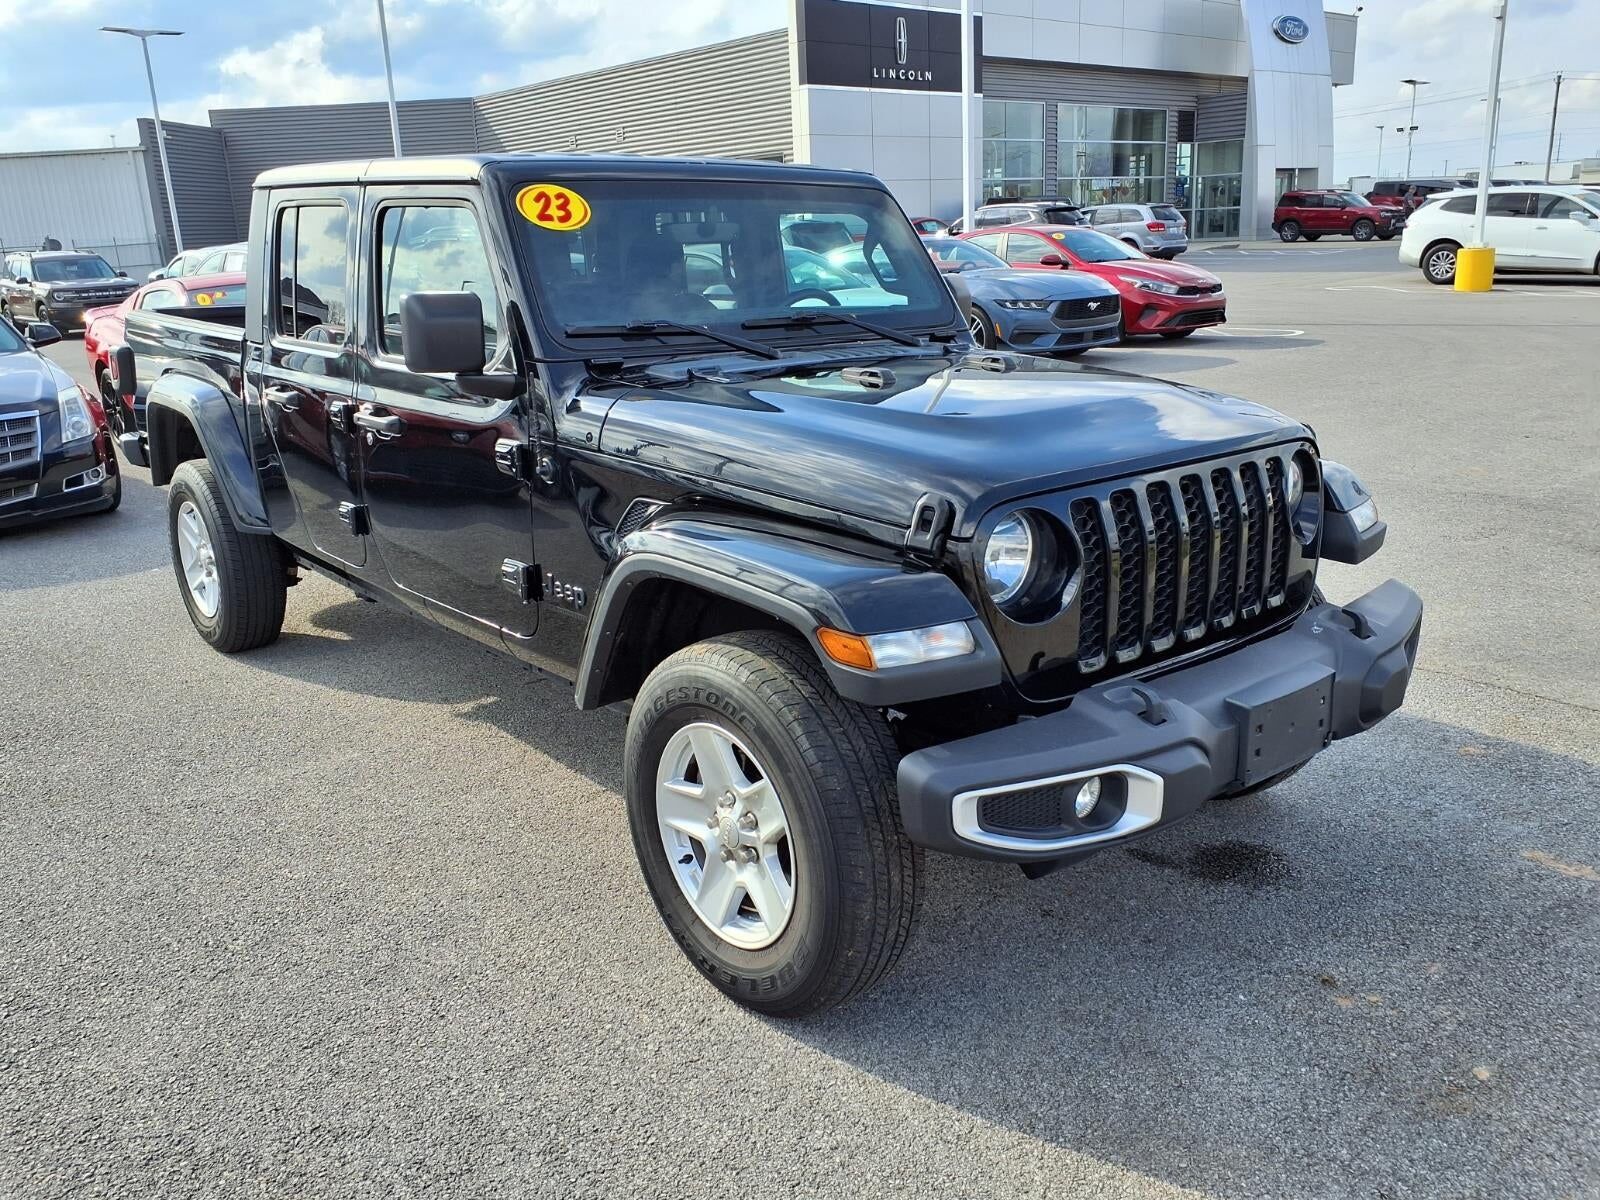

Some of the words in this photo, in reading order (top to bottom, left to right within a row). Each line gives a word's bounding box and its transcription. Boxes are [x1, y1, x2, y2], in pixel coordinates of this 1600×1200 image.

[1285, 20, 1304, 36] Ford
[873, 67, 932, 81] LINCOLN
[533, 191, 572, 223] 23
[542, 572, 586, 609] Jeep
